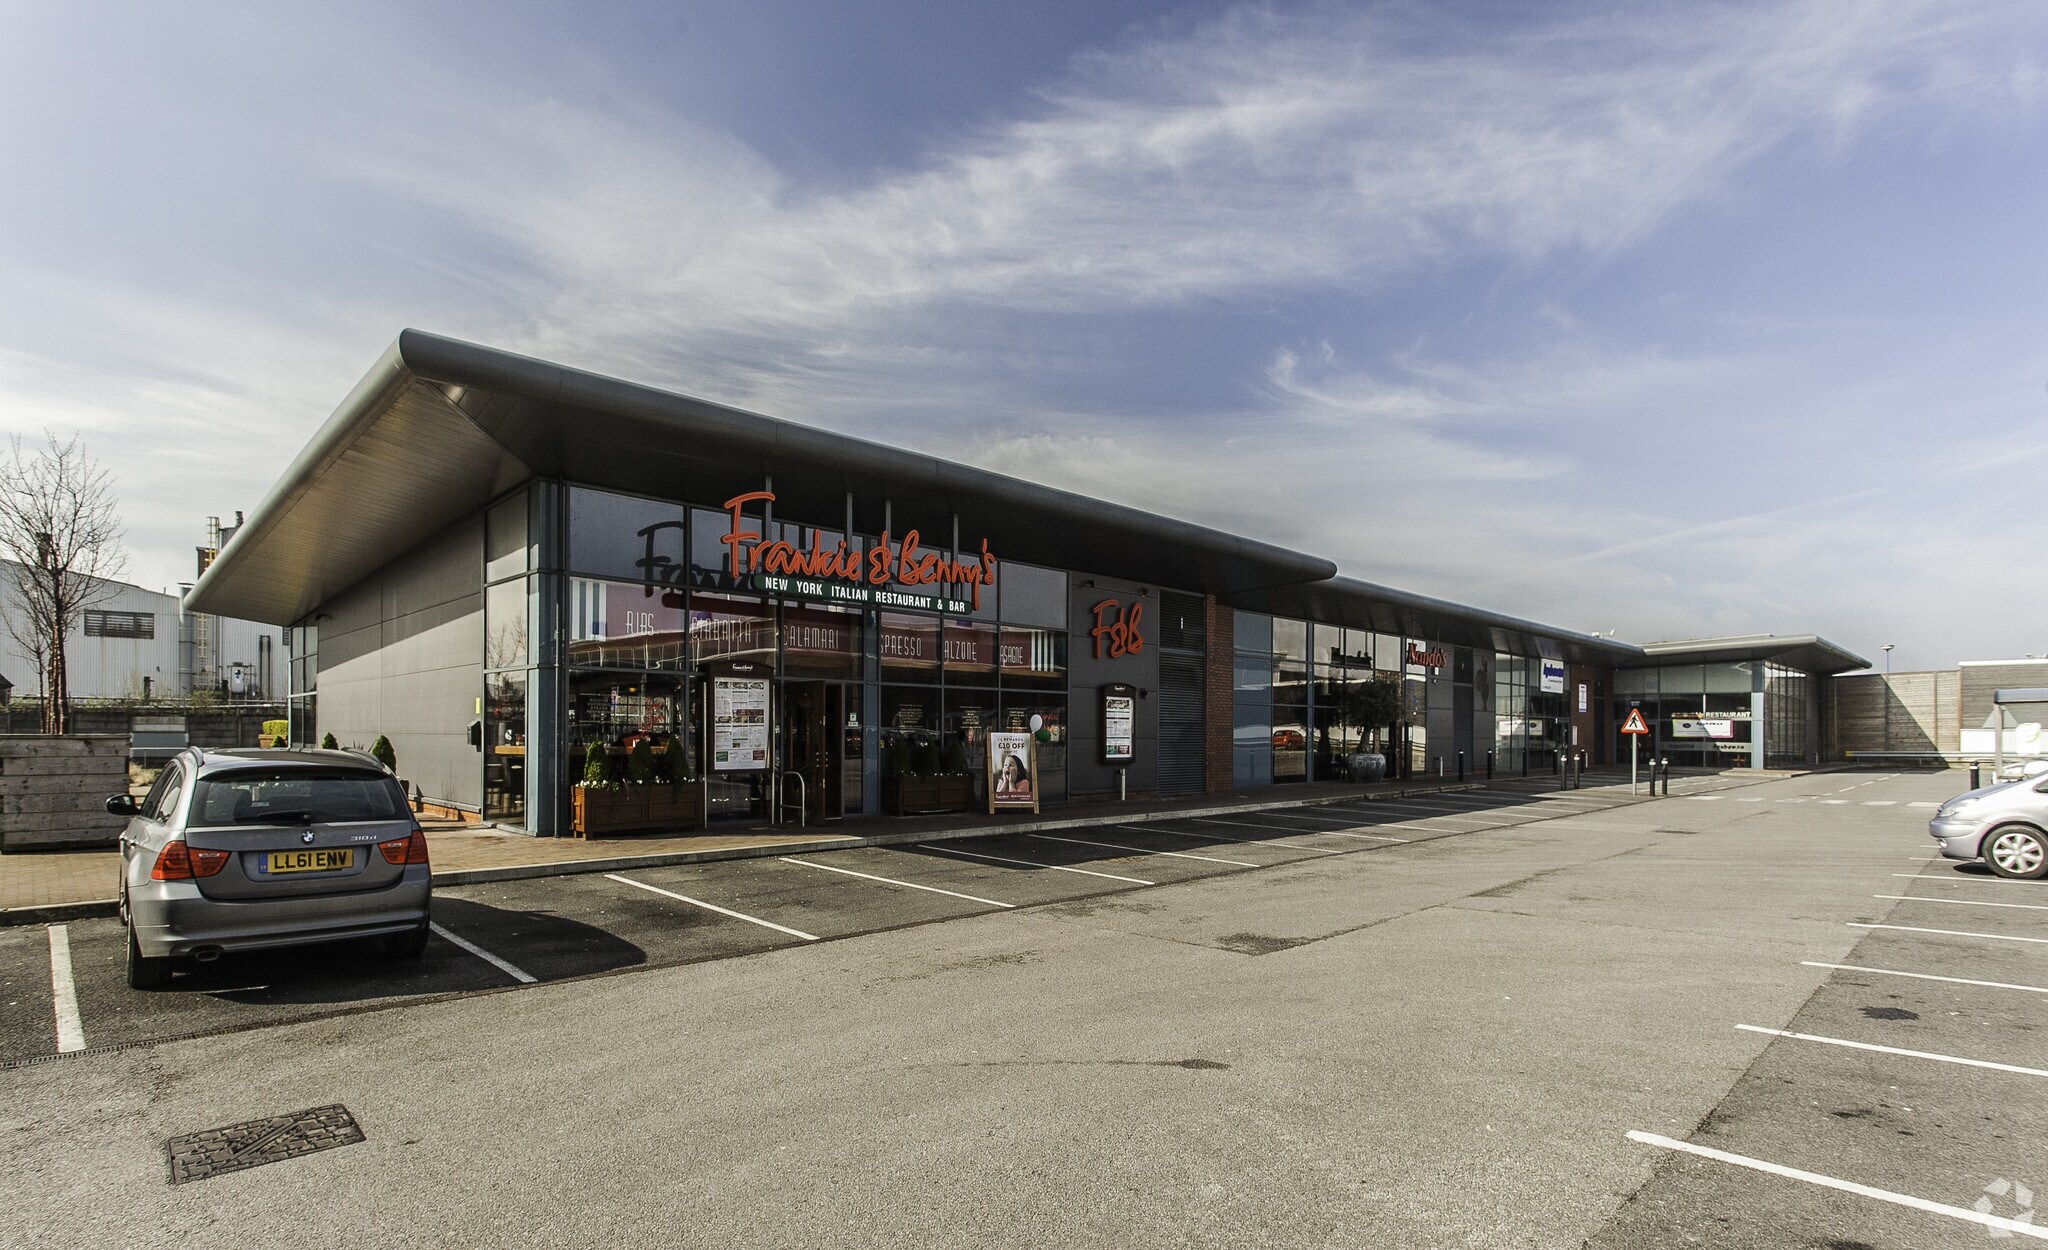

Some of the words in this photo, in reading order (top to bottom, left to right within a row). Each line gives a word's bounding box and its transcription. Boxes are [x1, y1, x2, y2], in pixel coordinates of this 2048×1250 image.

[721, 492, 862, 580] Frankie
[868, 530, 892, 585] &
[897, 529, 996, 611] Benny's
[765, 577, 788, 591] NEW
[796, 580, 823, 595] YORK
[831, 585, 868, 601] ITALIAN
[875, 591, 931, 608] RESTAURANT
[937, 599, 943, 610] &
[949, 600, 965, 613] BAR
[625, 610, 654, 636] RIBS
[783, 624, 840, 649] CALAMARI
[1406, 642, 1448, 668] Nando's
[998, 742, 1011, 750] £10
[1012, 742, 1025, 750] OFF
[274, 853, 312, 870] LL61
[316, 851, 348, 867] ENV
